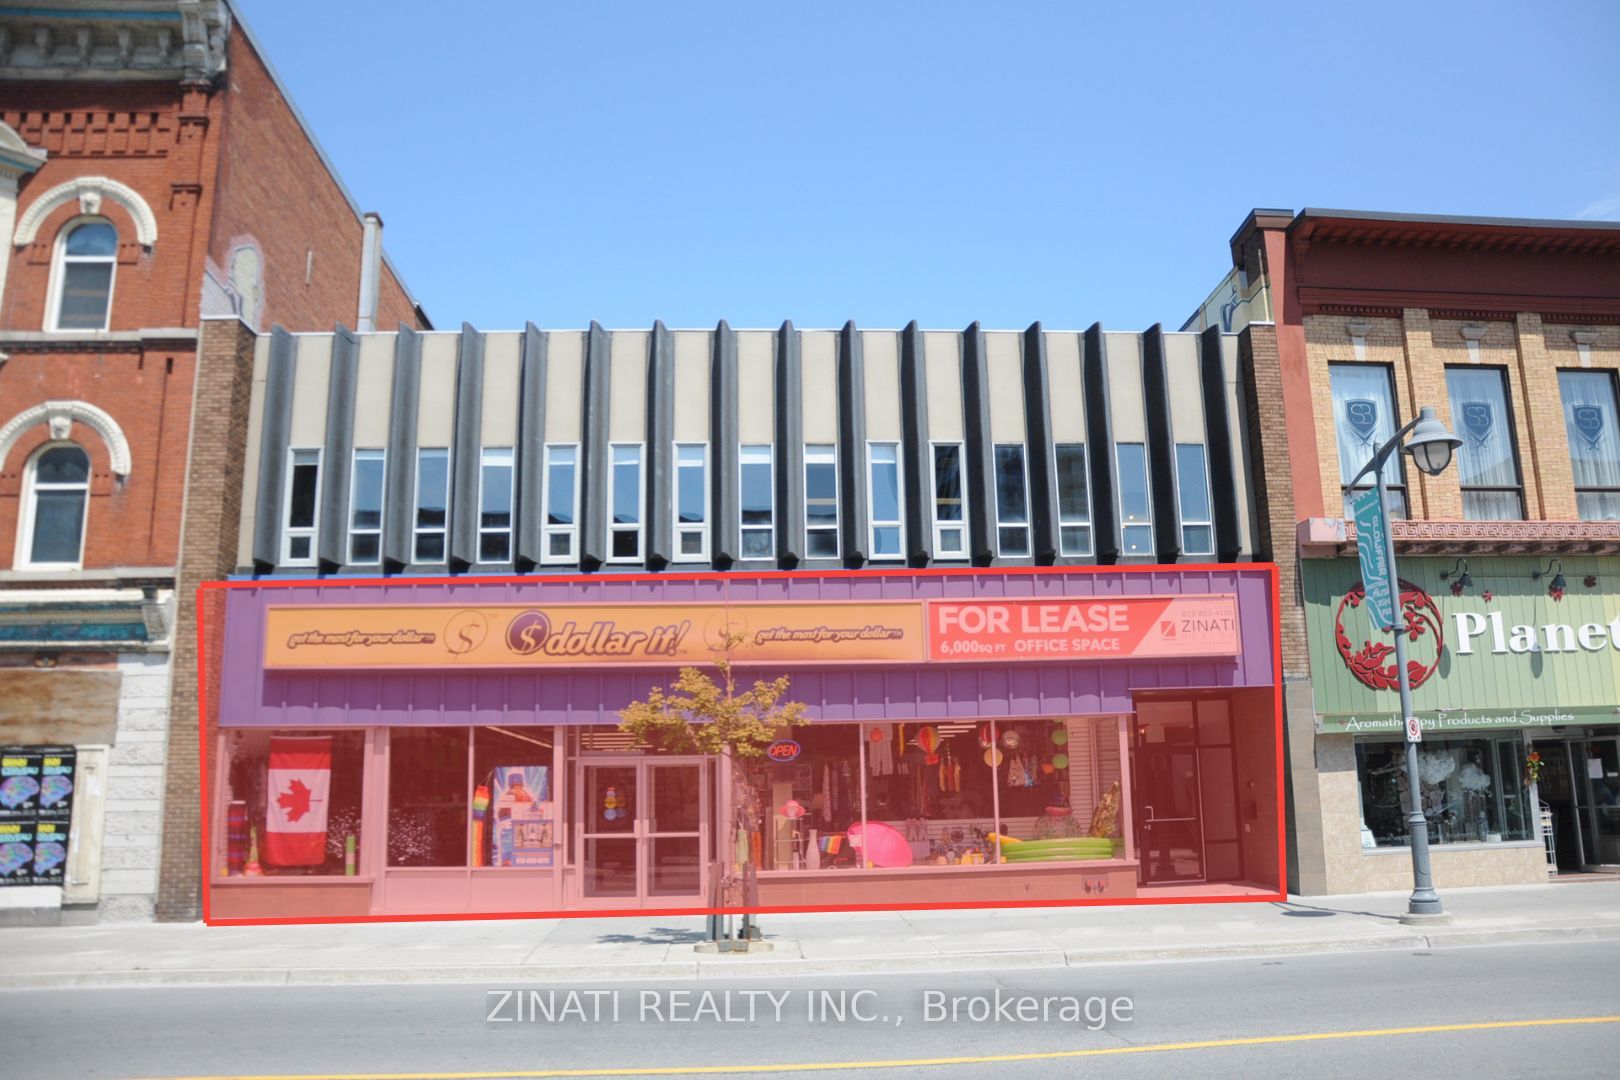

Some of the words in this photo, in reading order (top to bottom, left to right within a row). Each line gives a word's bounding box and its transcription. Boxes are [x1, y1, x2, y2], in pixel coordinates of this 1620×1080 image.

[938, 605, 1012, 634] FOR
[1021, 604, 1130, 633] LEASE
[1182, 619, 1235, 632] ZINATI
[287, 632, 307, 650] get
[307, 629, 325, 644] the
[324, 632, 348, 645] most
[345, 630, 366, 647] for
[363, 632, 393, 647] your
[391, 629, 424, 644] dollar
[545, 621, 648, 656] dollar
[645, 619, 691, 657] it!
[755, 629, 775, 645] get
[774, 627, 793, 641] the
[792, 629, 818, 642] most
[814, 626, 837, 643] for
[833, 629, 860, 643] your
[859, 626, 892, 640] dollar
[995, 643, 1007, 653] FT
[1014, 638, 1068, 653] OFFICE
[1072, 637, 1120, 652] SPACE
[1438, 712, 1491, 727] Products
[1495, 715, 1517, 725] and
[1519, 710, 1575, 726] Supplies
[769, 741, 798, 757] OPEN
